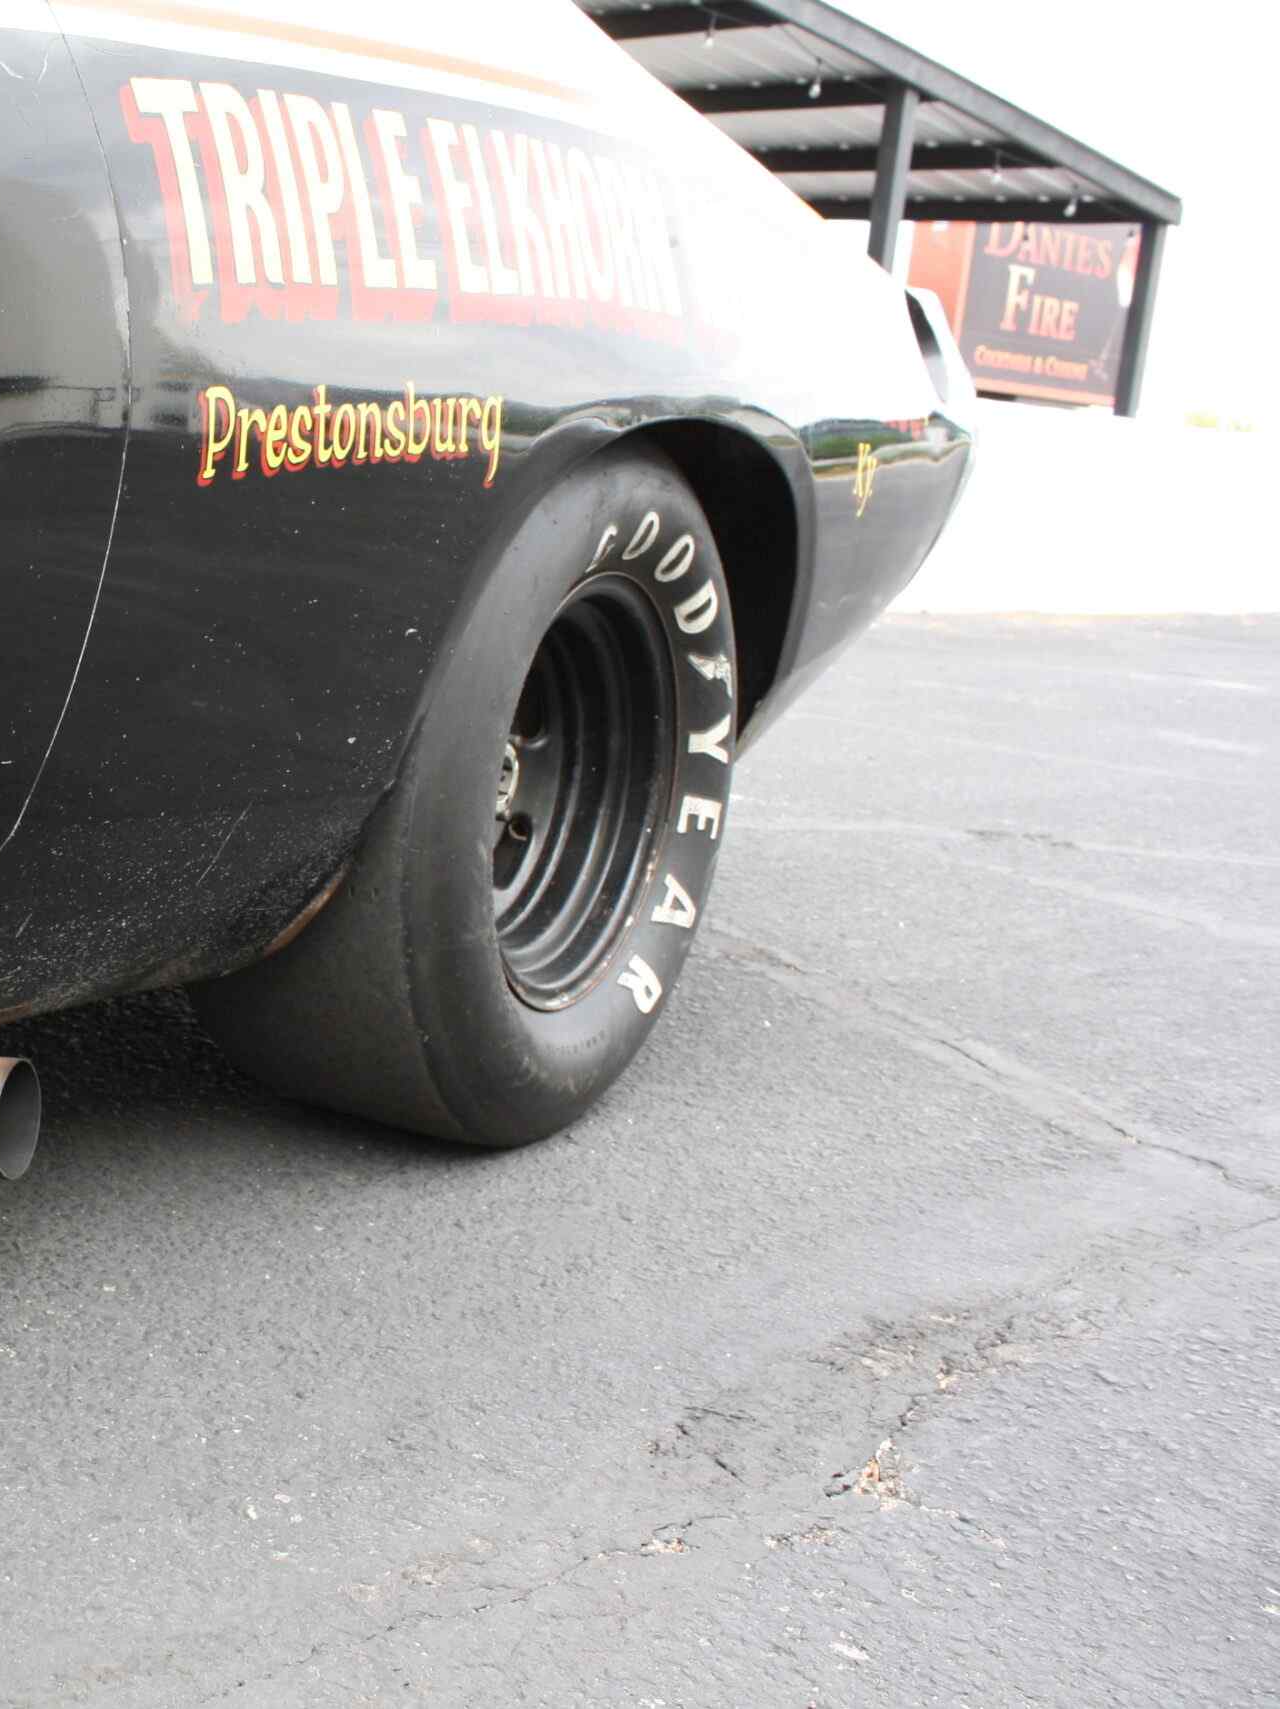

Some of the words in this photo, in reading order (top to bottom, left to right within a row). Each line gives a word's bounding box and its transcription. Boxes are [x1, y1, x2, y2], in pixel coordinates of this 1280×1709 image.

[120, 77, 440, 318] TRIPLE
[1000, 263, 1080, 341] FIRE
[197, 380, 505, 488] Prestonsburg
